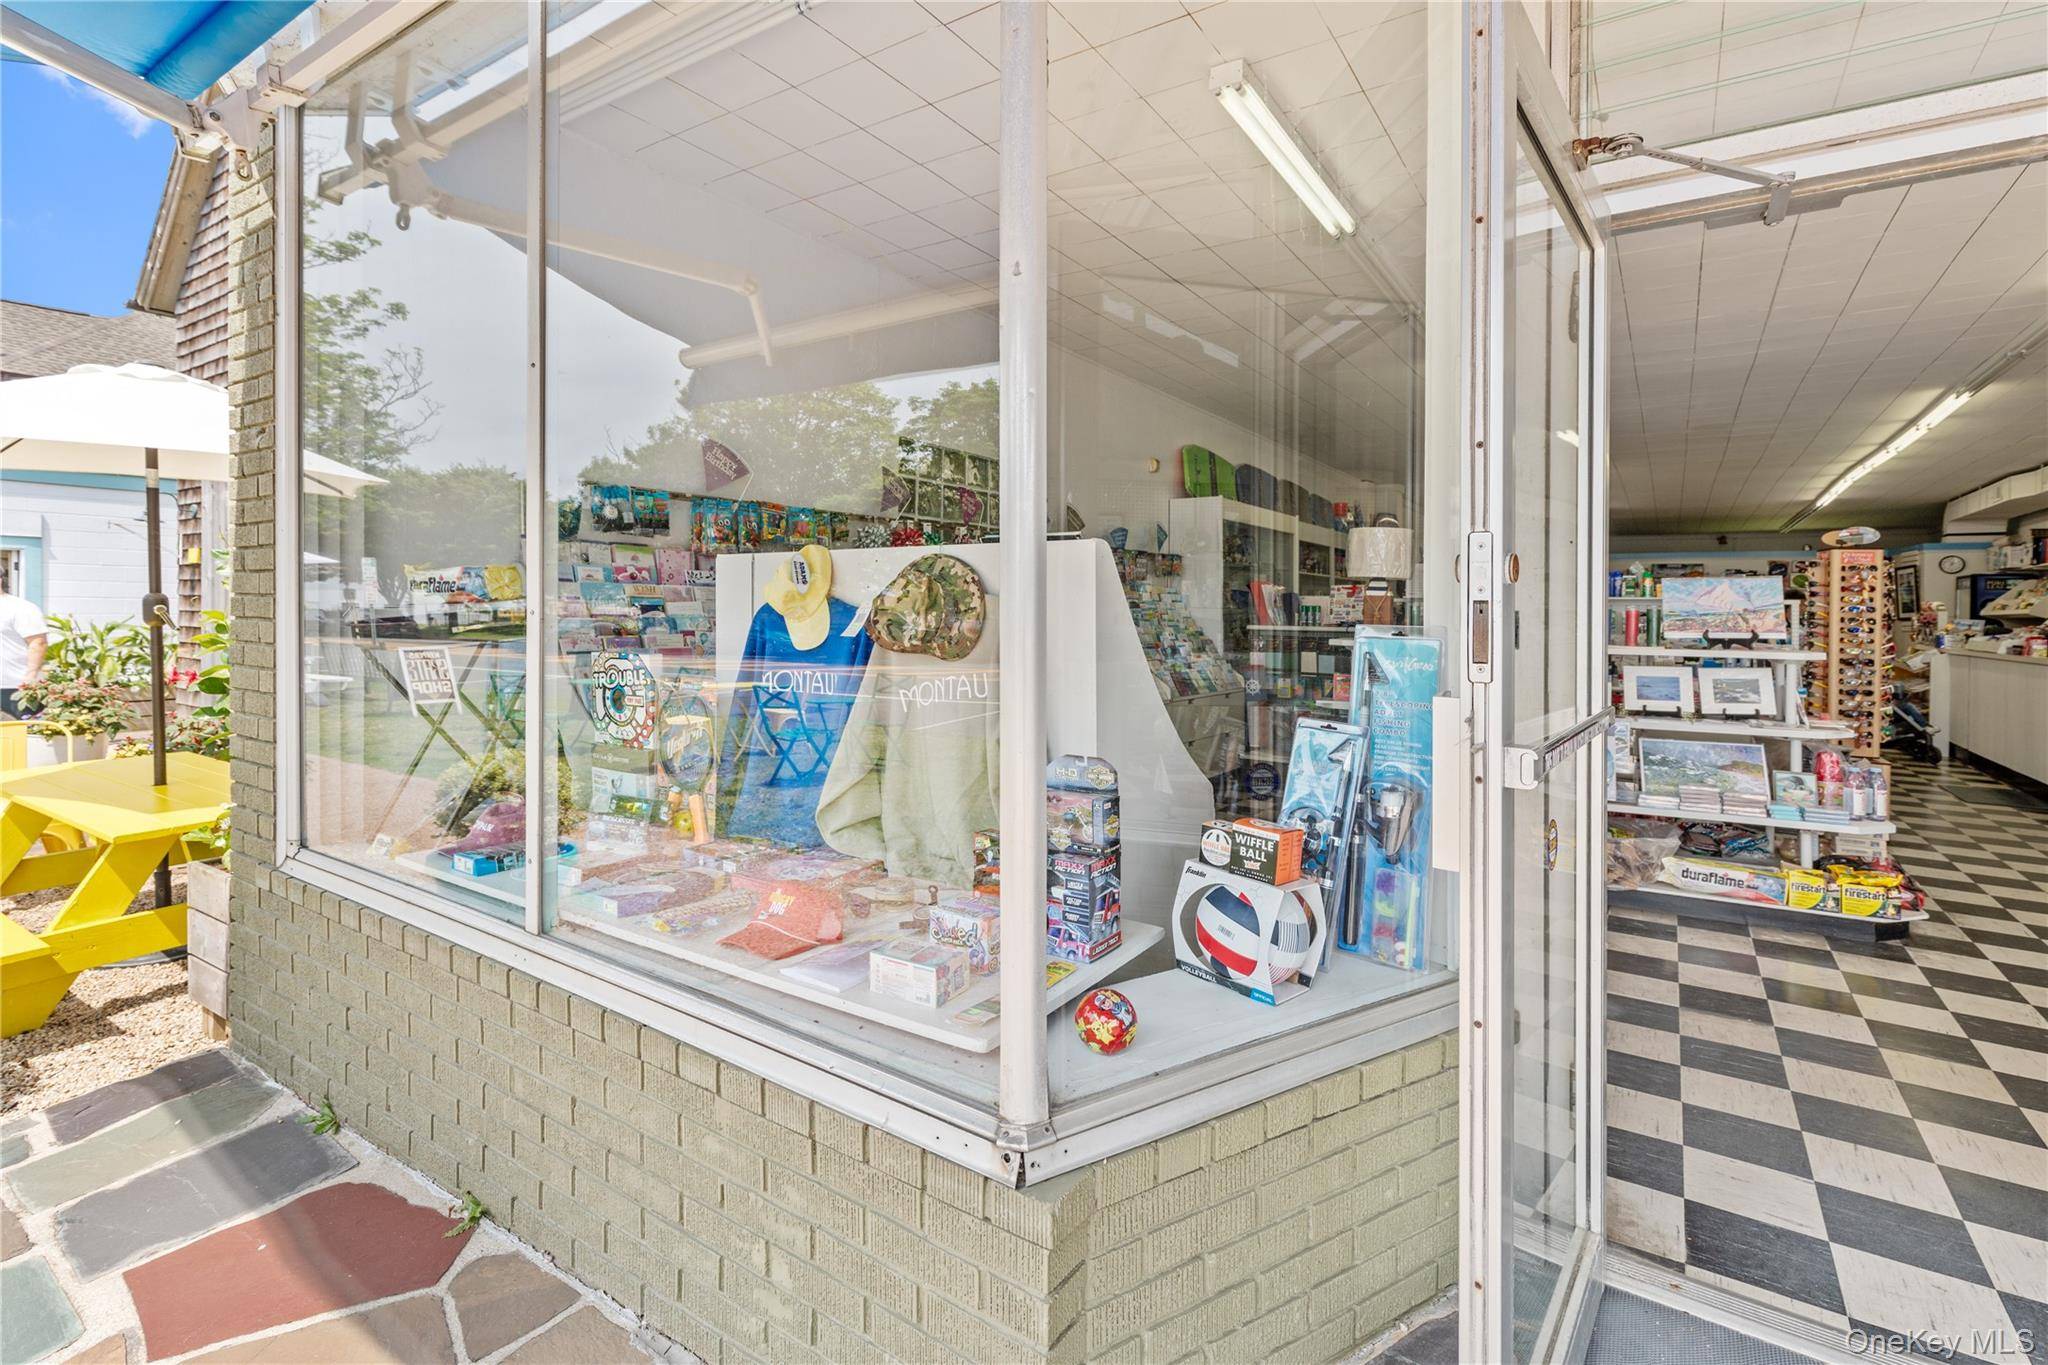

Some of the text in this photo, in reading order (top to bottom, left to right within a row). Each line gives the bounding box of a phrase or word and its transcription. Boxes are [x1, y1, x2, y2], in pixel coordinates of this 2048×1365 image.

[593, 669, 646, 688] TROUBLE
[762, 670, 838, 695] MONTAU
[1235, 832, 1275, 852] WIFFLE
[1240, 847, 1267, 862] BALL
[1681, 867, 1745, 889] duraflame
[1181, 964, 1217, 982] VOLLEYBALL
